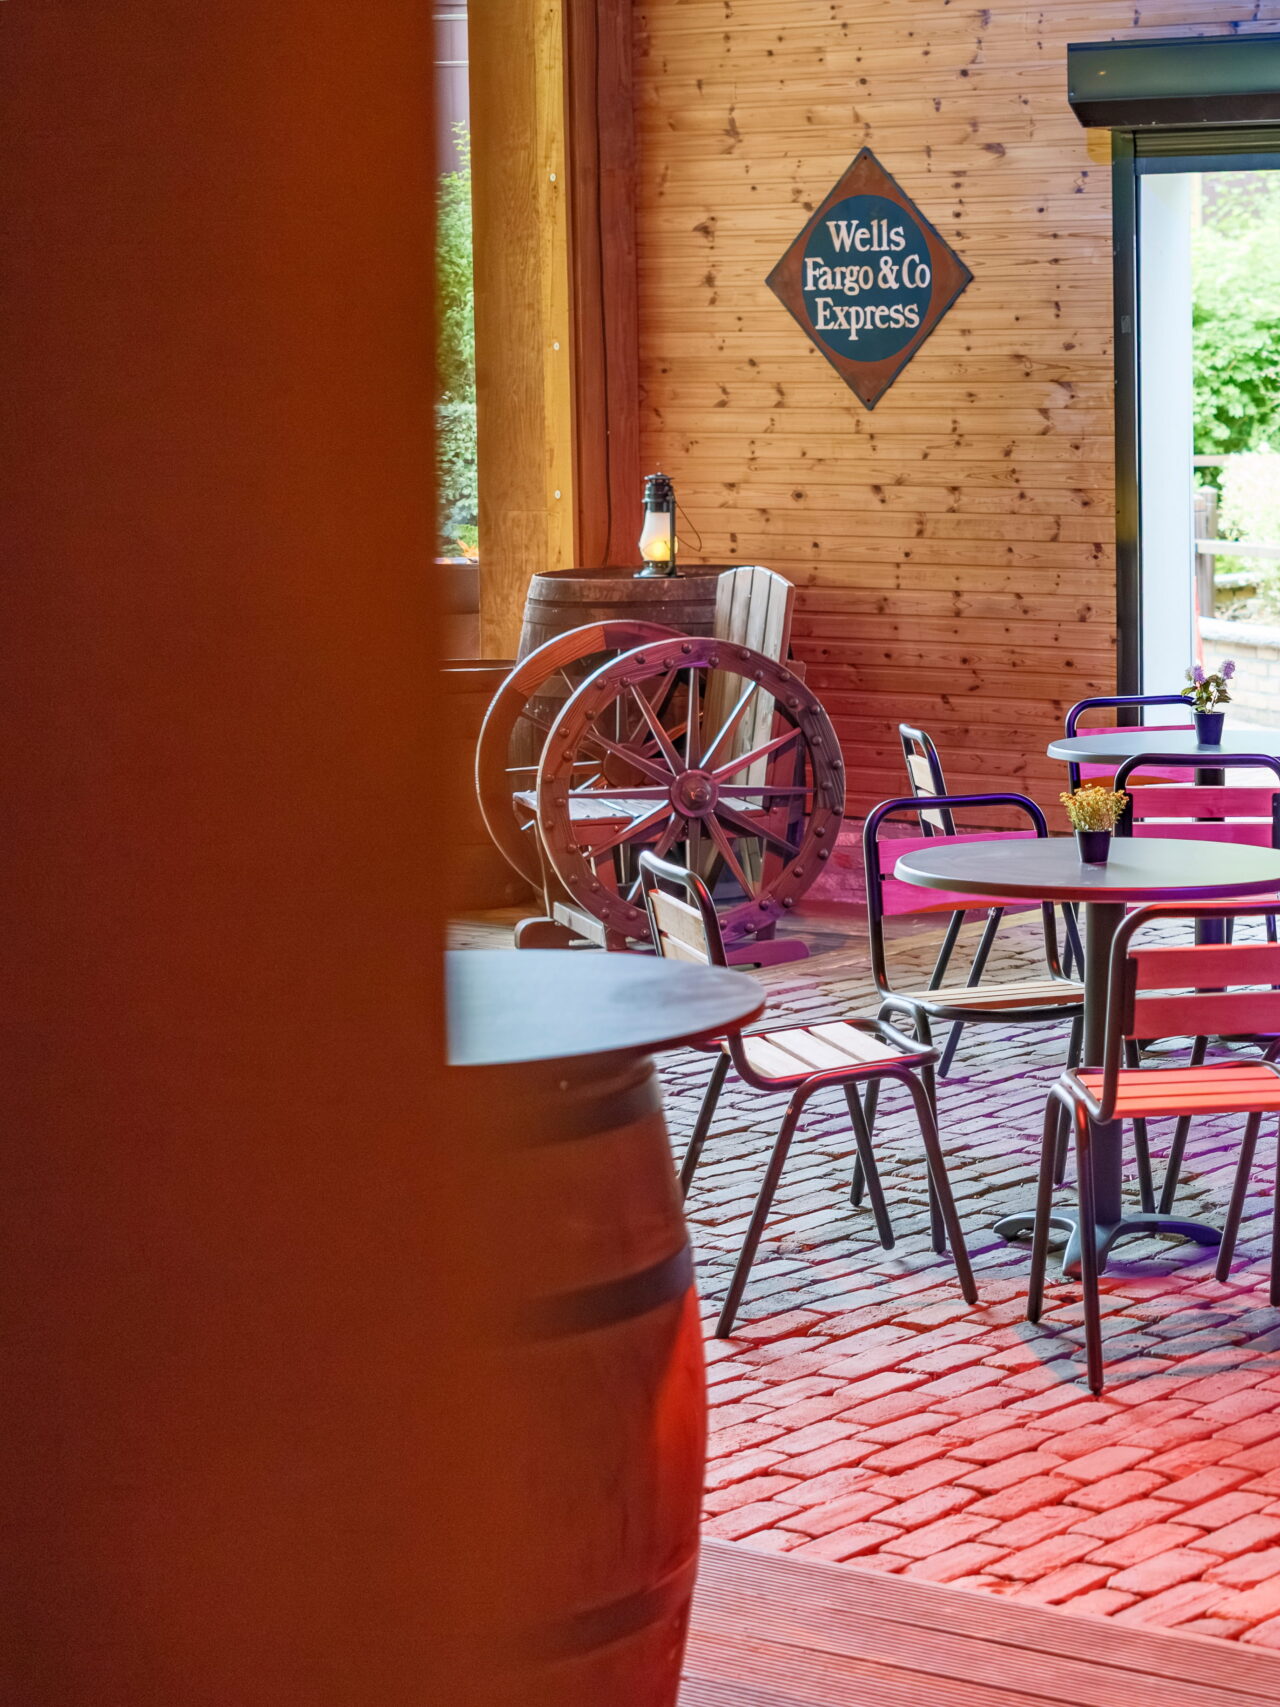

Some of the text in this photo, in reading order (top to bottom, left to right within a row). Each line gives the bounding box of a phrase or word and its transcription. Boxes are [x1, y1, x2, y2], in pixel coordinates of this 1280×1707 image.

[825, 218, 906, 253] Wells
[804, 257, 874, 296] Fargo
[815, 297, 920, 341] Express
